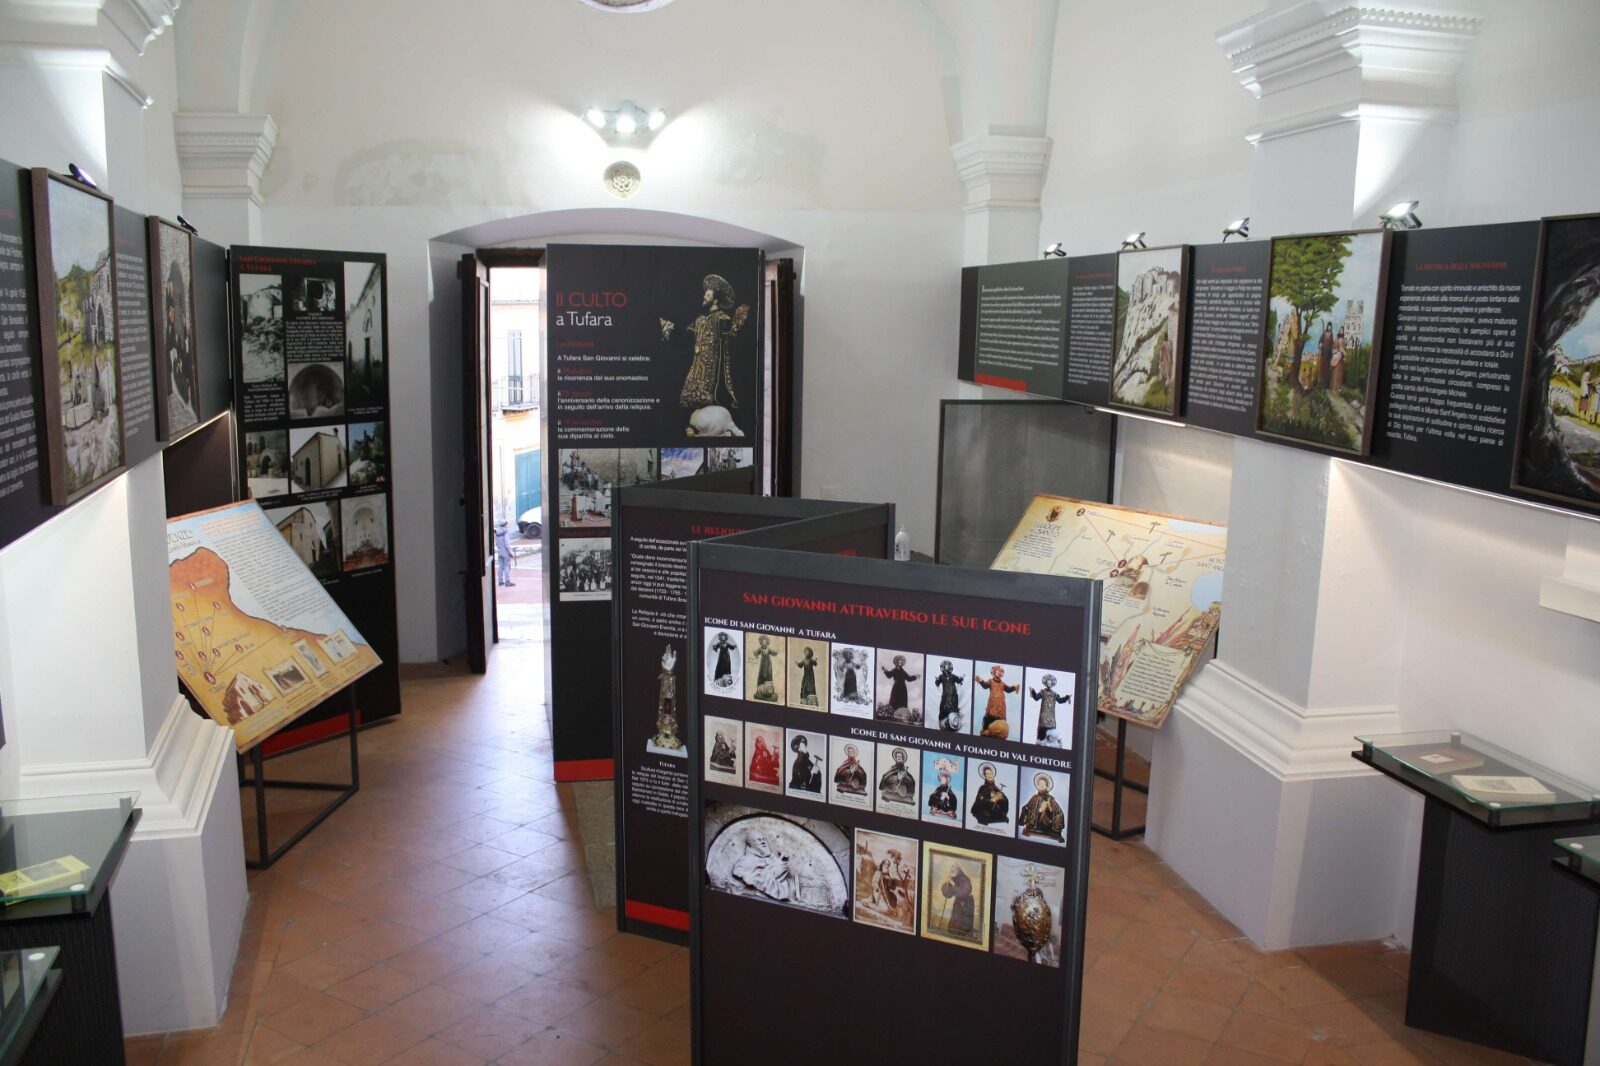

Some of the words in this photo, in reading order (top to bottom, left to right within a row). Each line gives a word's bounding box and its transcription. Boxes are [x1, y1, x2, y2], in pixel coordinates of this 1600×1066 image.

[569, 292, 627, 308] CULTO
[556, 316, 564, 326] a
[566, 311, 612, 326] Tufara
[743, 592, 768, 604] SAN
[771, 596, 836, 613] GIOVANNI
[840, 604, 928, 623] ATTRAVERSO
[932, 614, 948, 625] LE
[952, 616, 978, 629] SUE
[983, 619, 1031, 635] ICONE
[704, 617, 728, 626] ICONE
[740, 621, 755, 630] SAN
[756, 623, 795, 634] GIOVANNI
[806, 629, 836, 639] TUFARA
[851, 729, 877, 738] ICONE
[879, 732, 888, 740] DI
[890, 734, 907, 742] SAN
[908, 736, 951, 750] GIOVANNI
[963, 745, 998, 758] FOIANO
[1000, 750, 1009, 759] DI
[1012, 752, 1028, 762] VAL
[1030, 755, 1072, 769] FORTORE
